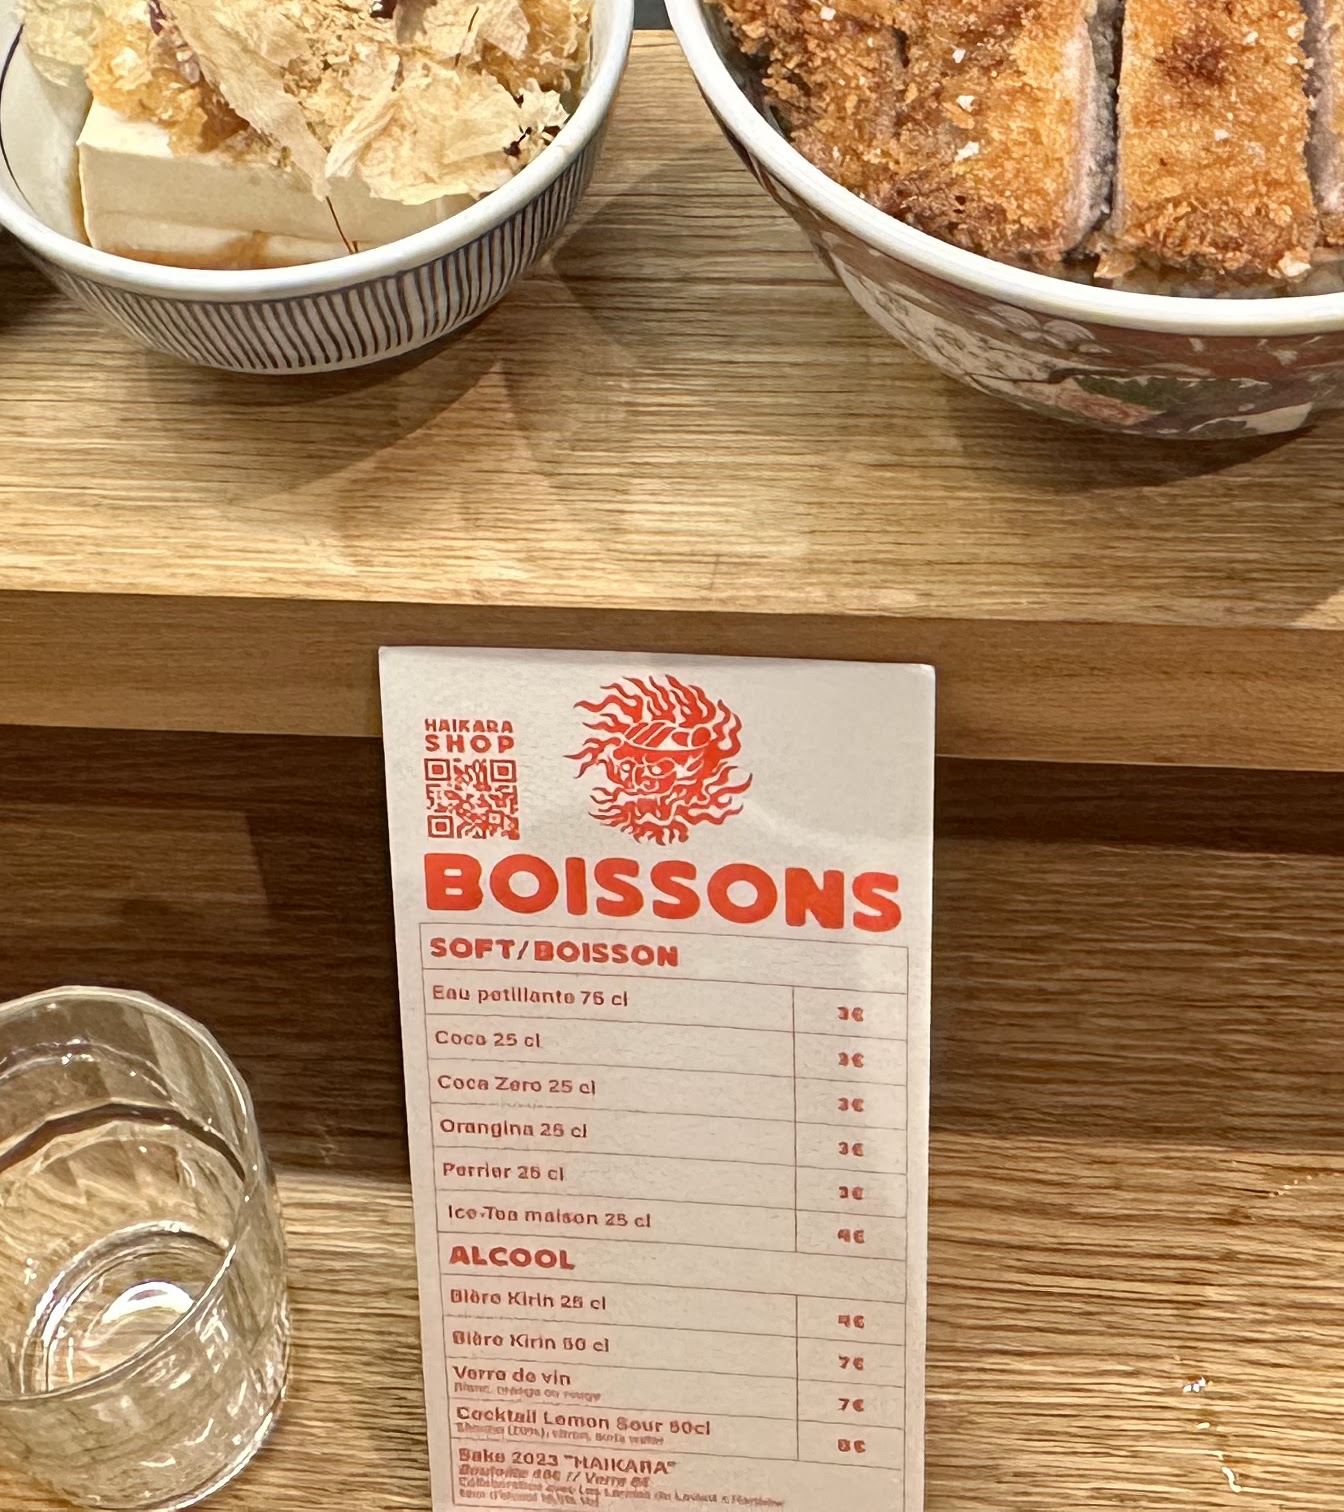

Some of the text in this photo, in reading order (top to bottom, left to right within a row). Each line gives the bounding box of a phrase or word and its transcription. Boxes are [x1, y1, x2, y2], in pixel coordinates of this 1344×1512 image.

[424, 718, 514, 735] HAIKARA
[424, 734, 515, 753] SHOP
[423, 853, 902, 932] BOISSONS
[430, 938, 680, 968] SOFT/BOISSON
[435, 1030, 541, 1049] Coca 25 cl
[437, 1075, 489, 1091] Coca
[548, 1079, 573, 1094] 25
[579, 1080, 596, 1096] cl
[440, 1118, 534, 1138] Orangina
[571, 1124, 588, 1139] cl
[443, 1162, 511, 1179] Perrier
[548, 1167, 565, 1181] cl
[634, 1213, 651, 1229] cl
[449, 1245, 576, 1270] ALCOOL
[507, 1291, 555, 1308] Kirin
[590, 1296, 607, 1310] cl
[510, 1334, 556, 1350] Kirin
[592, 1338, 610, 1352] cl
[512, 1367, 536, 1383] de
[542, 1369, 571, 1386] vin
[616, 1416, 664, 1433] Sour
